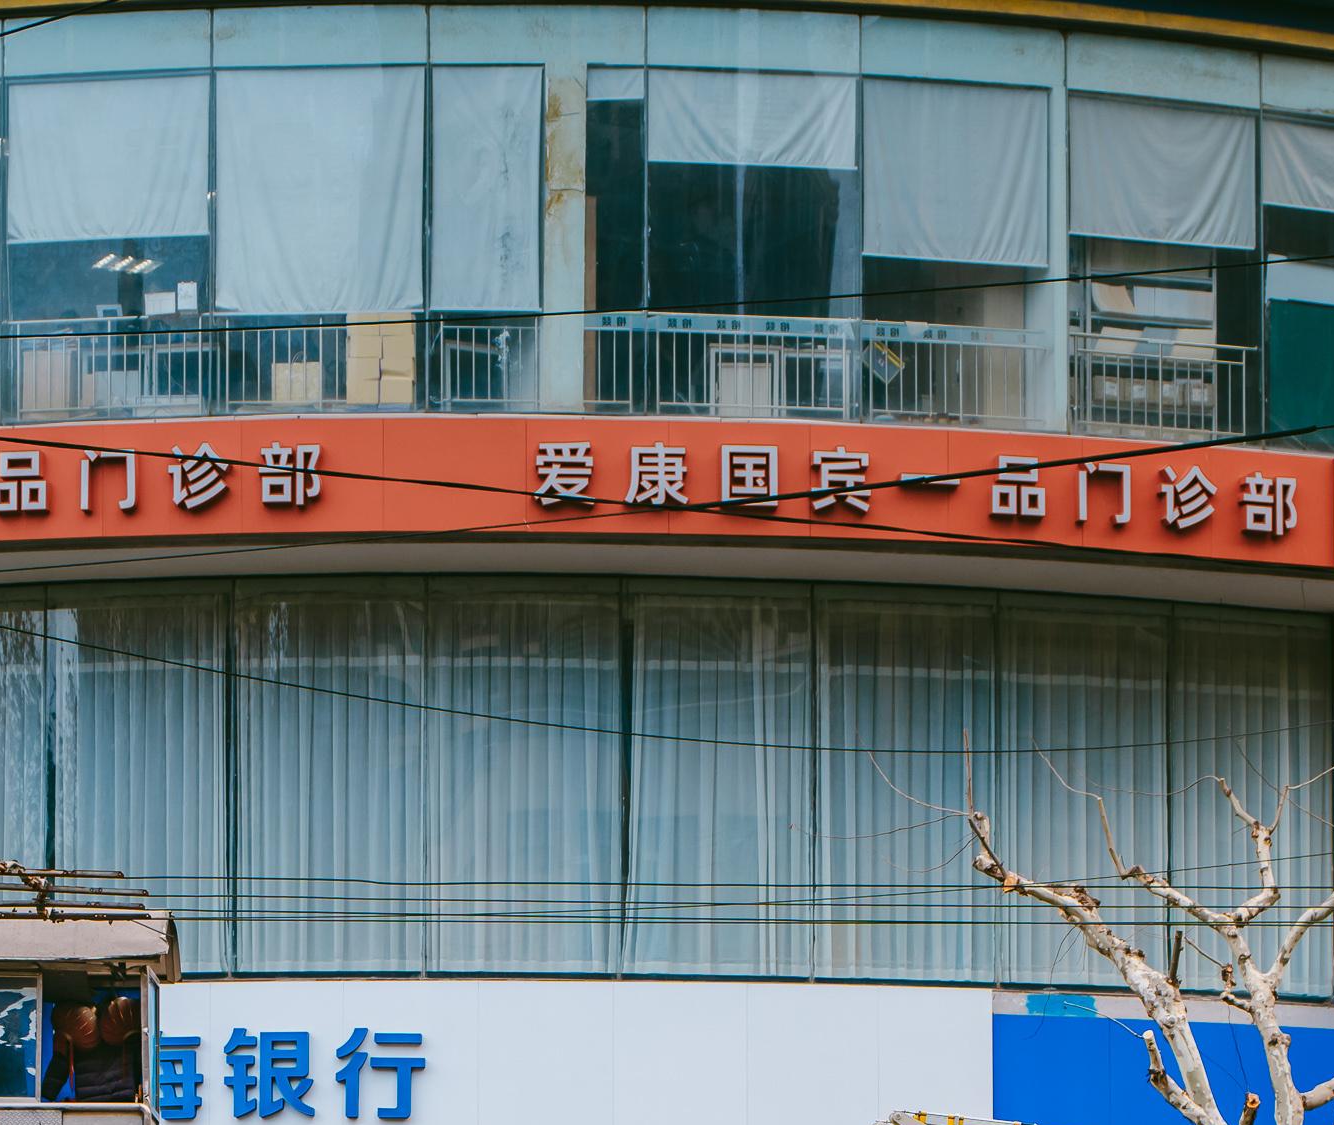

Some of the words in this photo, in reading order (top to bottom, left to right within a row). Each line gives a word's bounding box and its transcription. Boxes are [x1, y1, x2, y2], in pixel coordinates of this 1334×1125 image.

[534, 442, 1299, 536] 爱康国宾一品门诊部
